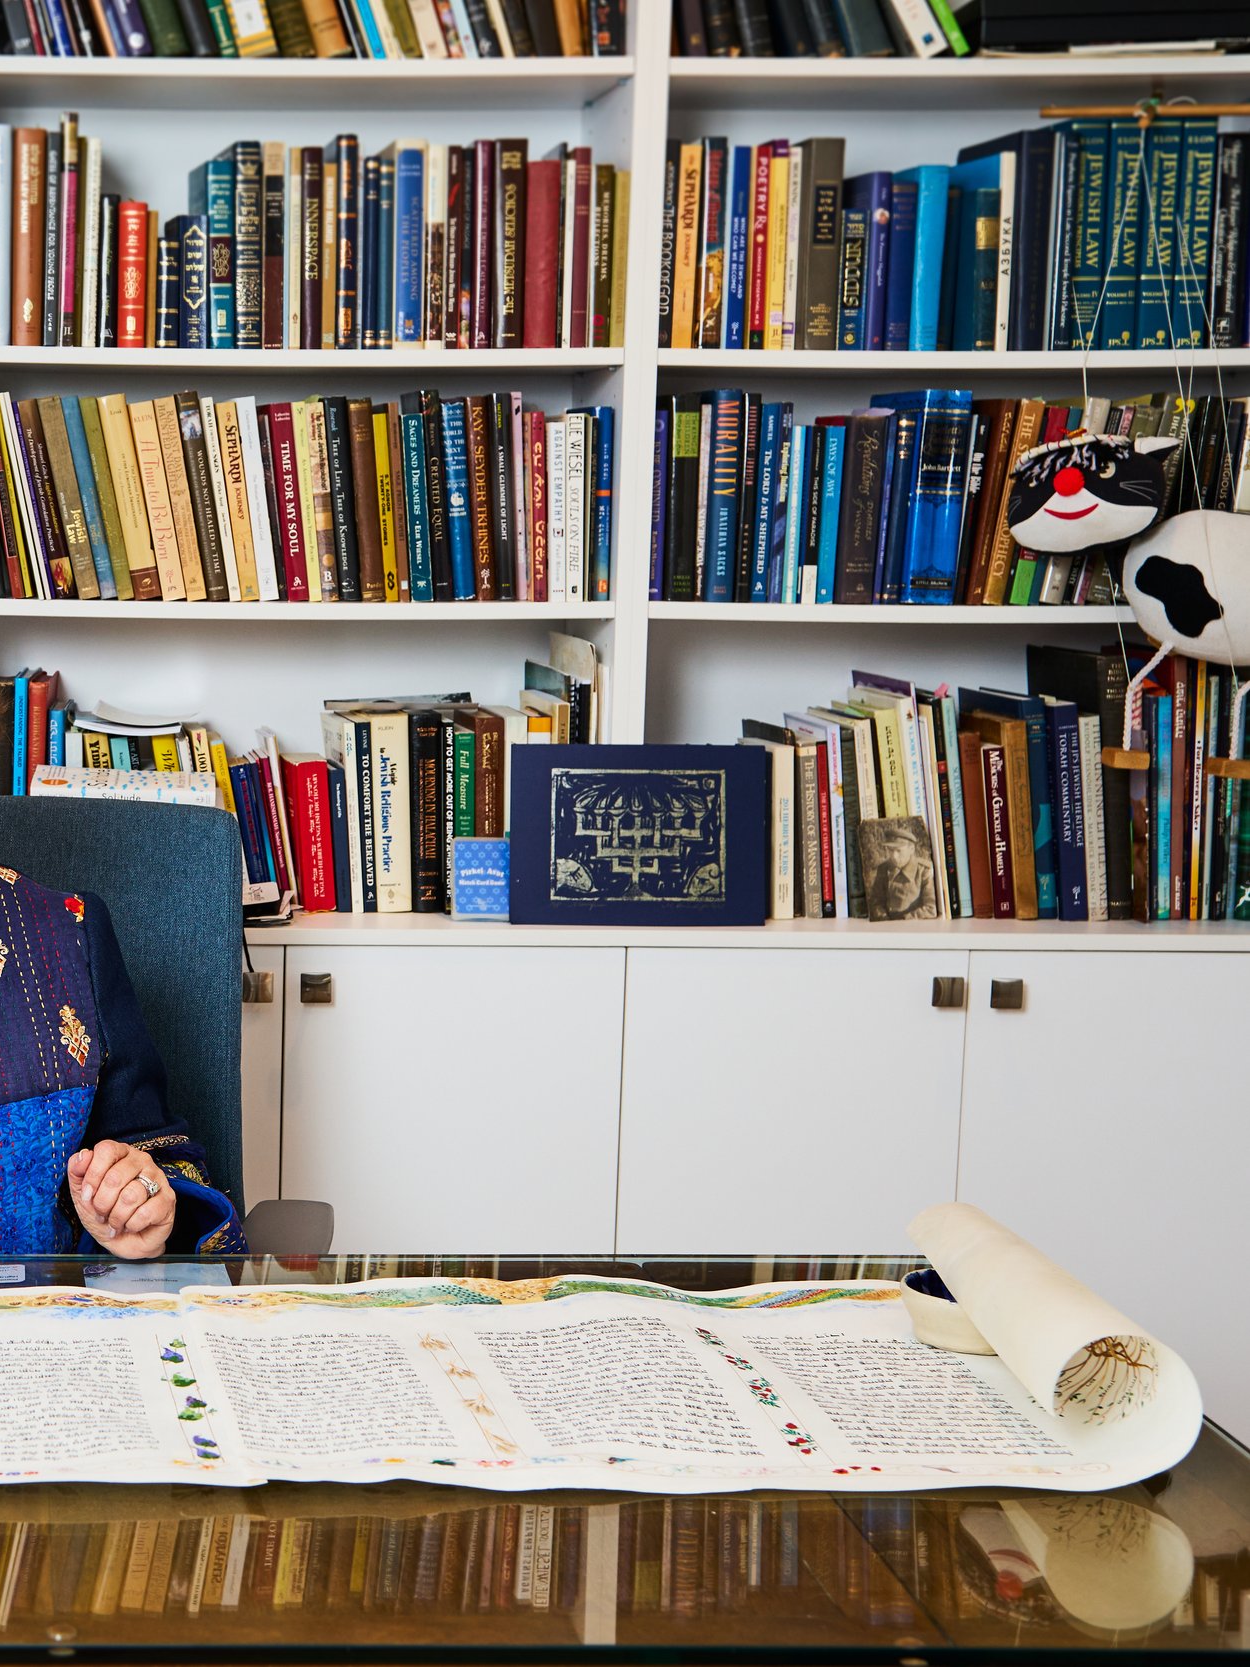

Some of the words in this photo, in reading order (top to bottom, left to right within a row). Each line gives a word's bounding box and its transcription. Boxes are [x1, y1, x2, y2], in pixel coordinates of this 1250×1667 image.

[758, 157, 767, 211] POETRY
[1087, 154, 1103, 222] JEWISH
[1194, 152, 1213, 220] JEWISH
[305, 198, 319, 280] INNERSPACE
[660, 232, 673, 271] BOOK
[1001, 217, 1011, 276] АЗБУКА
[1086, 228, 1099, 268] LAW
[1193, 227, 1208, 266] LAW
[844, 241, 862, 307] SIDDUR
[408, 419, 418, 448] SAGES
[472, 406, 483, 433] KAY
[140, 440, 156, 453] A
[280, 441, 291, 472] TIME
[410, 450, 418, 467] AND
[554, 429, 562, 472] AGAINST
[713, 400, 740, 497] MORALITY
[764, 450, 772, 465] The
[143, 459, 161, 488] Time
[196, 450, 208, 486] WOUNDS
[430, 457, 441, 503] CREATED
[474, 446, 486, 501] SEYDER
[762, 467, 771, 495] LORD
[149, 490, 162, 502] to
[202, 488, 211, 505] NOT
[283, 475, 293, 500] FOR
[411, 470, 422, 515] DREAMERS
[554, 477, 562, 523] EMPATHY
[71, 509, 88, 543] Jewish
[153, 505, 169, 523] Be
[204, 507, 215, 540] HEALED
[285, 502, 295, 520] MY
[433, 508, 443, 542] EQUAL
[718, 508, 729, 548] JONATHAN
[760, 506, 769, 520] MY
[66, 524, 78, 544] Law
[154, 527, 172, 560] Born
[287, 523, 300, 556] SOUL
[477, 504, 489, 563] TKHINES
[756, 522, 768, 574] SHEPHERD
[211, 553, 220, 574] TIME
[716, 551, 726, 576] SACKS
[361, 754, 370, 767] TO
[459, 750, 469, 768] Full
[1059, 733, 1068, 768] TORAH
[1195, 746, 1203, 760] For
[215, 747, 226, 777] LEARNED
[221, 778, 232, 809] OPTIMISM
[379, 755, 391, 787] Jewish
[424, 759, 436, 803] MOURNING
[805, 759, 814, 779] THE
[1072, 765, 1081, 799] JEWISH
[1193, 763, 1201, 802] Heaven's
[362, 770, 371, 818] COMFORT
[425, 804, 435, 813] IN
[459, 772, 470, 810] Measure
[806, 782, 816, 822] HISTORY
[1061, 771, 1072, 843] COMMENTARY
[363, 819, 372, 837] THE
[380, 790, 391, 834] Religious
[989, 750, 1000, 789] MEMOIRS
[995, 841, 1007, 876] HAMELN
[1074, 802, 1084, 847] HERITAGE
[807, 825, 816, 838] OF
[364, 839, 374, 886] BEREAVED
[381, 836, 393, 873] Practice
[808, 840, 818, 886] MANNERS
